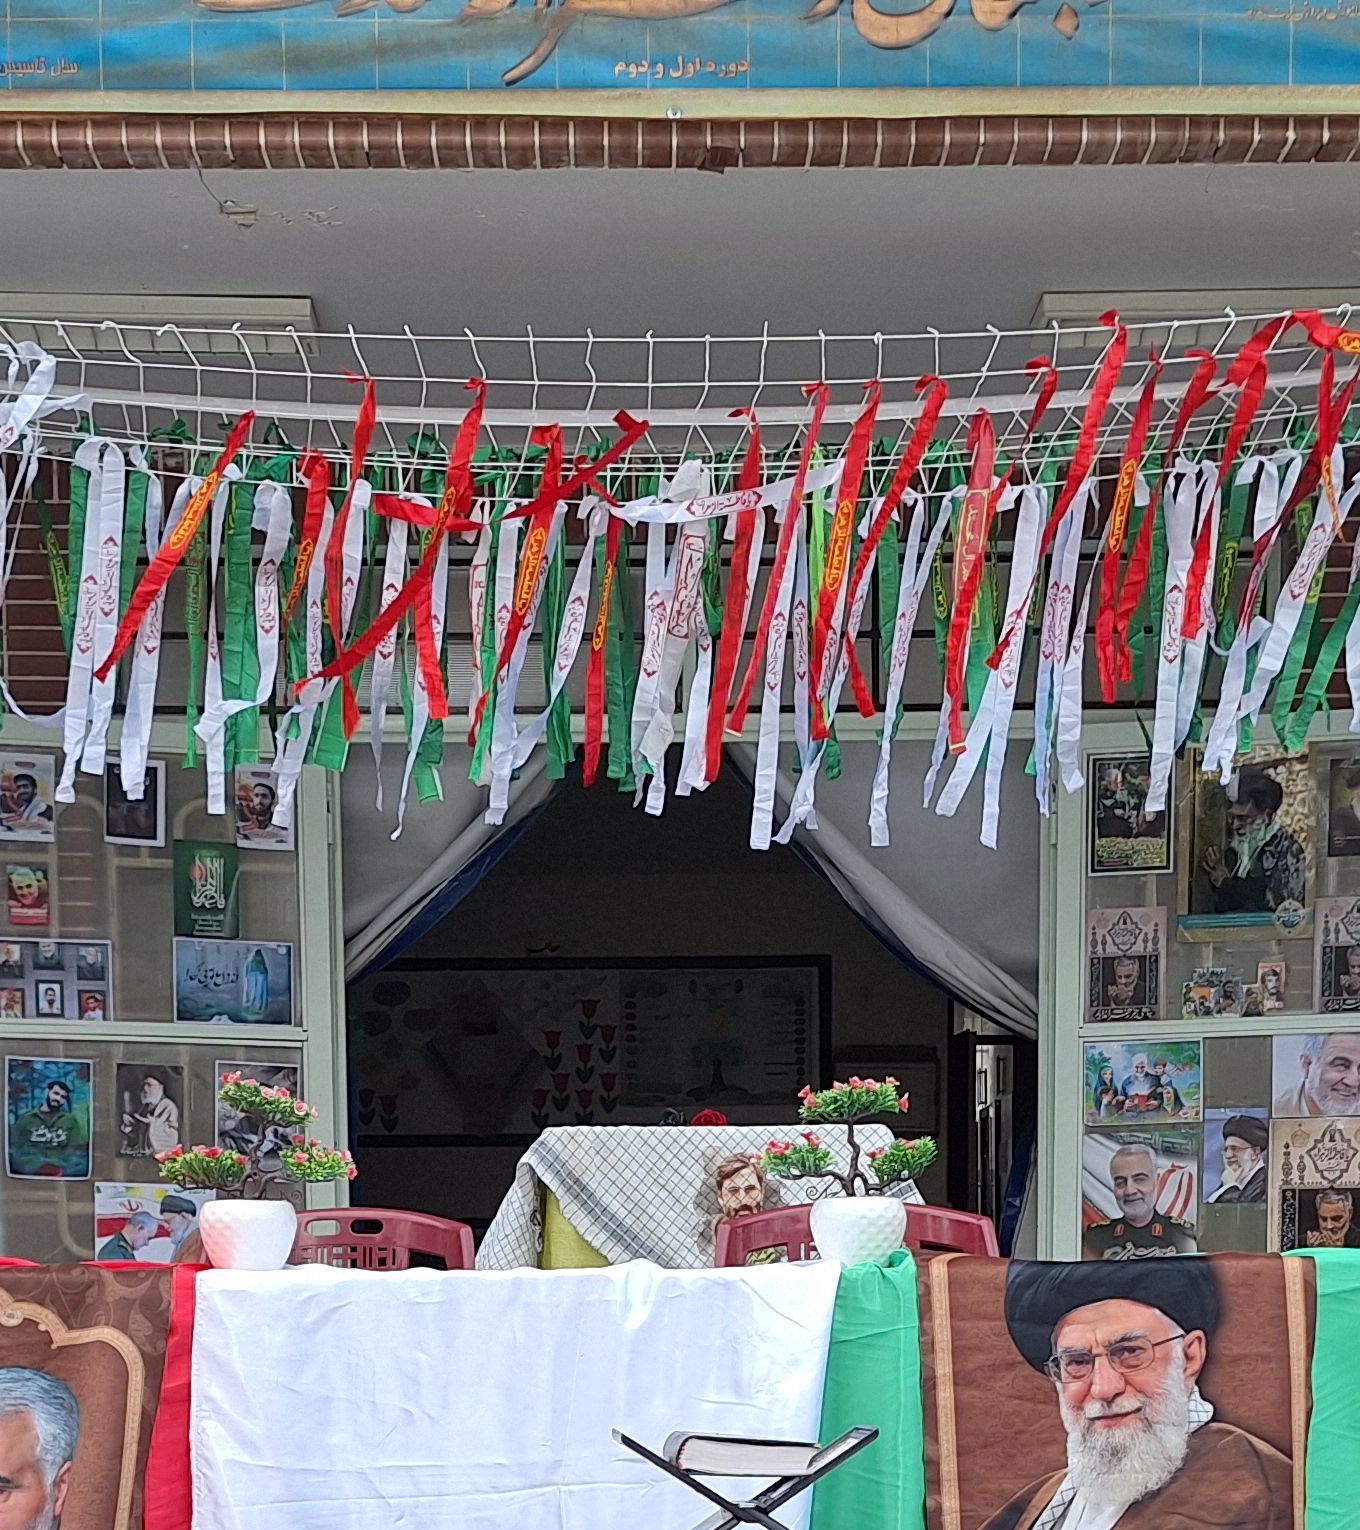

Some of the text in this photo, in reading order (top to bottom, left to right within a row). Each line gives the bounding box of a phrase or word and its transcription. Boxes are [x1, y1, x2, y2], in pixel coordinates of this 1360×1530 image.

[51, 57, 80, 77] سال
[614, 55, 750, 78] دوره اول و دوم
